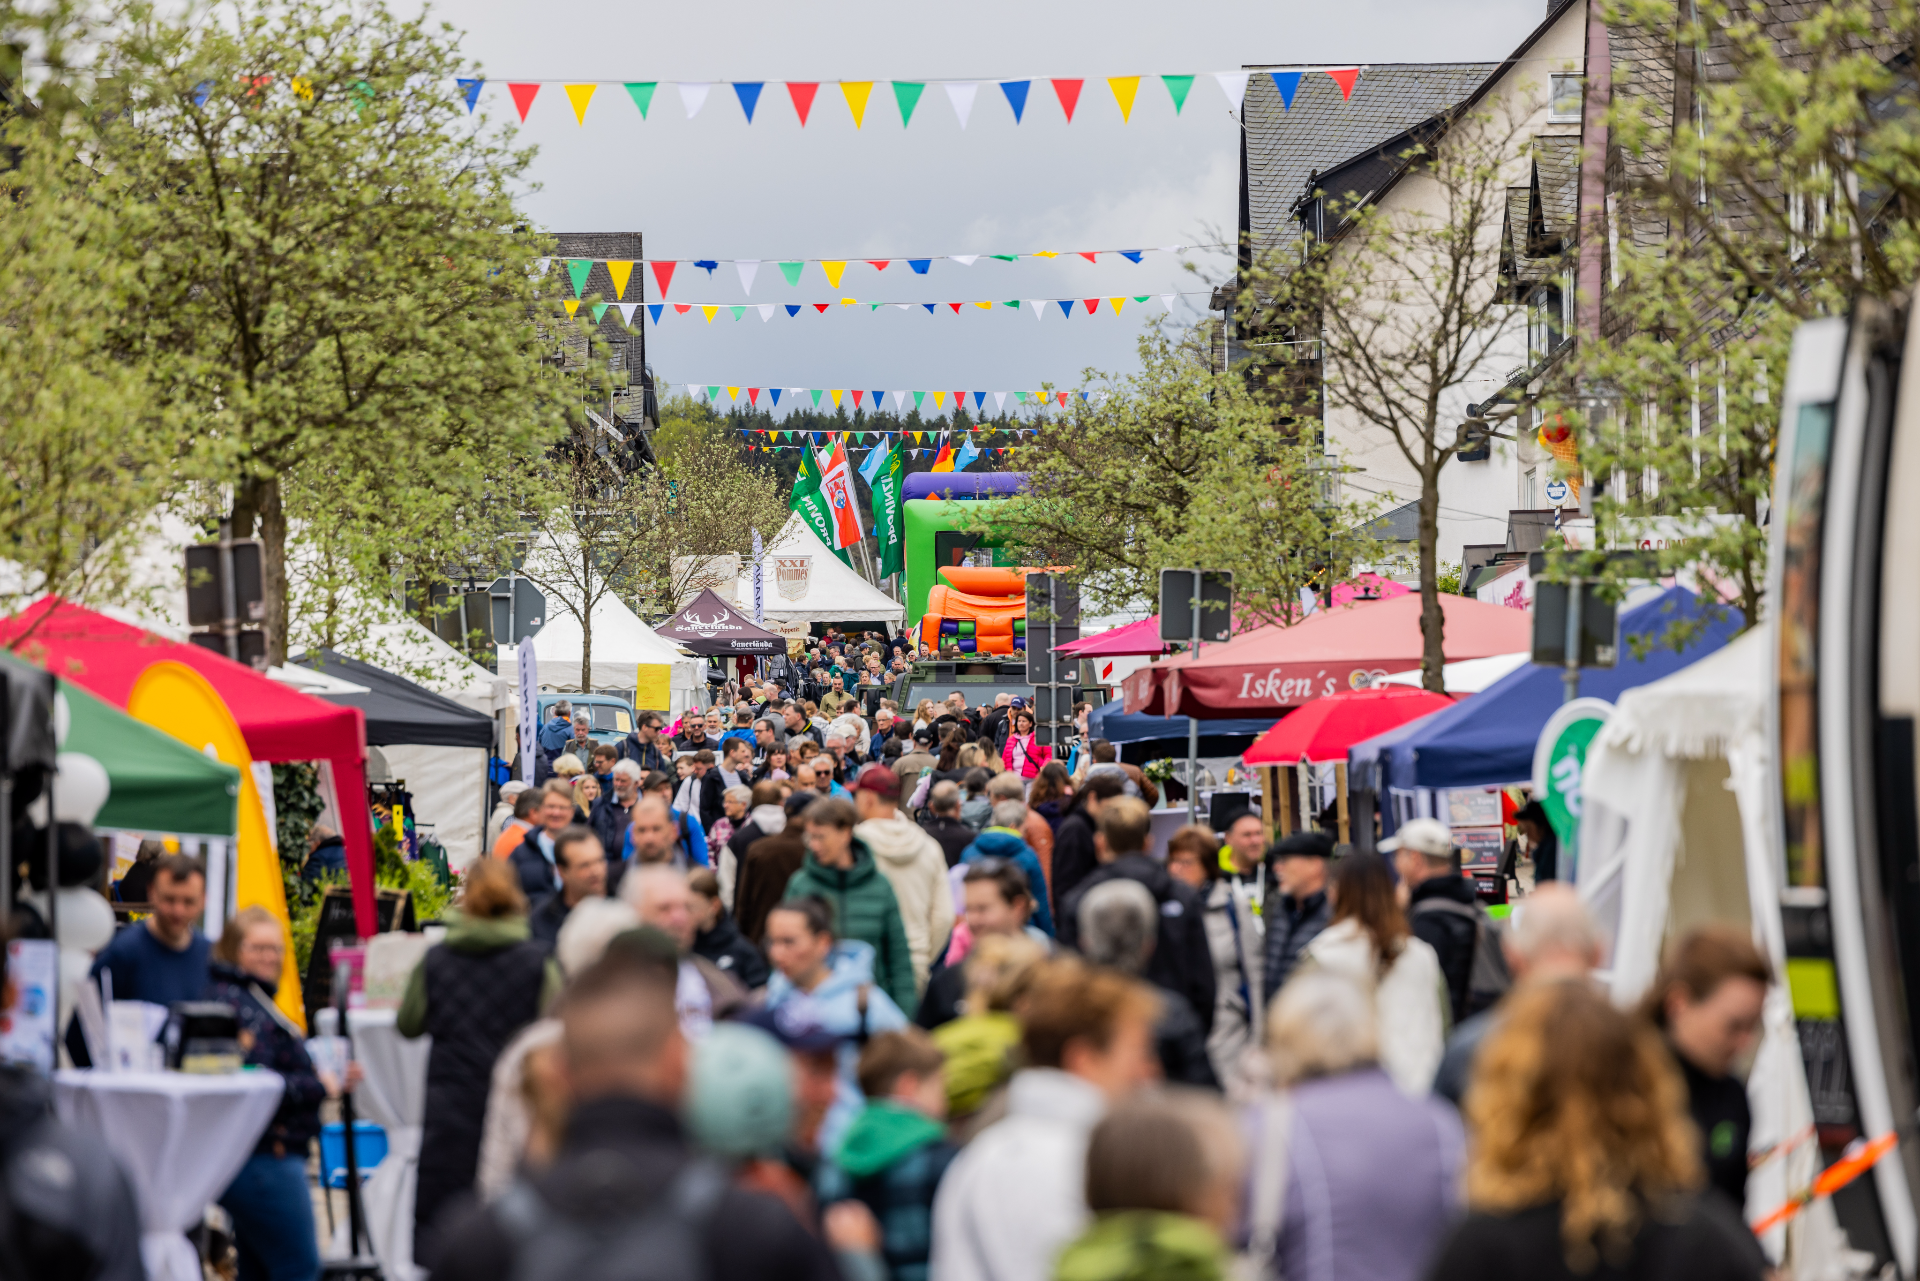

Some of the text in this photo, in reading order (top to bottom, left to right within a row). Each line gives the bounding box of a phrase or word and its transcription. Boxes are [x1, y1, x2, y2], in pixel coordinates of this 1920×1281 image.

[776, 560, 807, 568] XXL
[776, 567, 809, 581] Pommes
[731, 639, 773, 647] Sauerlända
